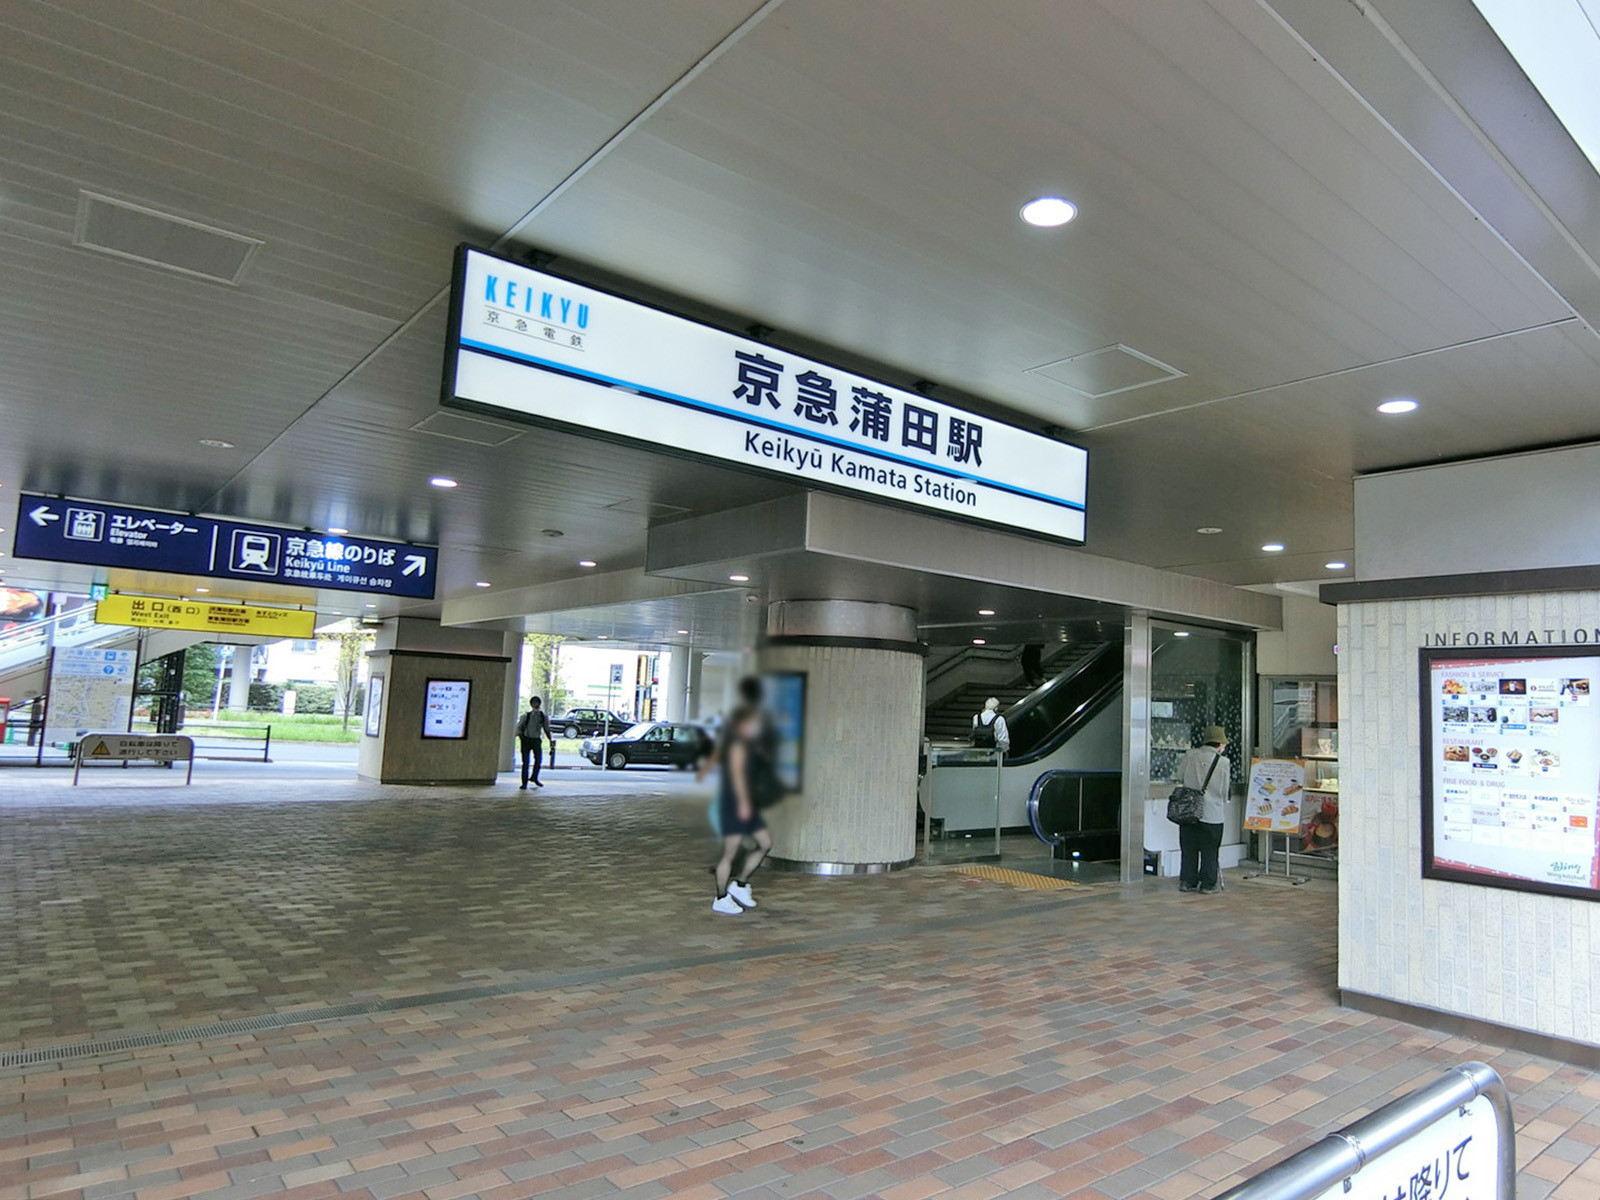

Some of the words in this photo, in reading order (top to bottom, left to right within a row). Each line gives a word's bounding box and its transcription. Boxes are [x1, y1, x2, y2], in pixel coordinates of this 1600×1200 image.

[485, 275, 589, 329] KEIKYU
[486, 310, 583, 348] 京急電鉄
[732, 350, 983, 467] 京急蒲田駅
[745, 430, 822, 470] Keikyū
[831, 452, 907, 489] Kamata
[914, 474, 977, 506] Station
[110, 514, 199, 535] エレベーター
[110, 527, 149, 540] Elevator
[285, 536, 396, 566] 京急線のりば
[327, 561, 351, 573] Line
[131, 610, 152, 618] West
[1441, 670, 1469, 678] FASHION
[1442, 738, 1484, 746] RESTAURANT
[1459, 778, 1477, 786] FOOD
[1486, 780, 1505, 788] DRUG
